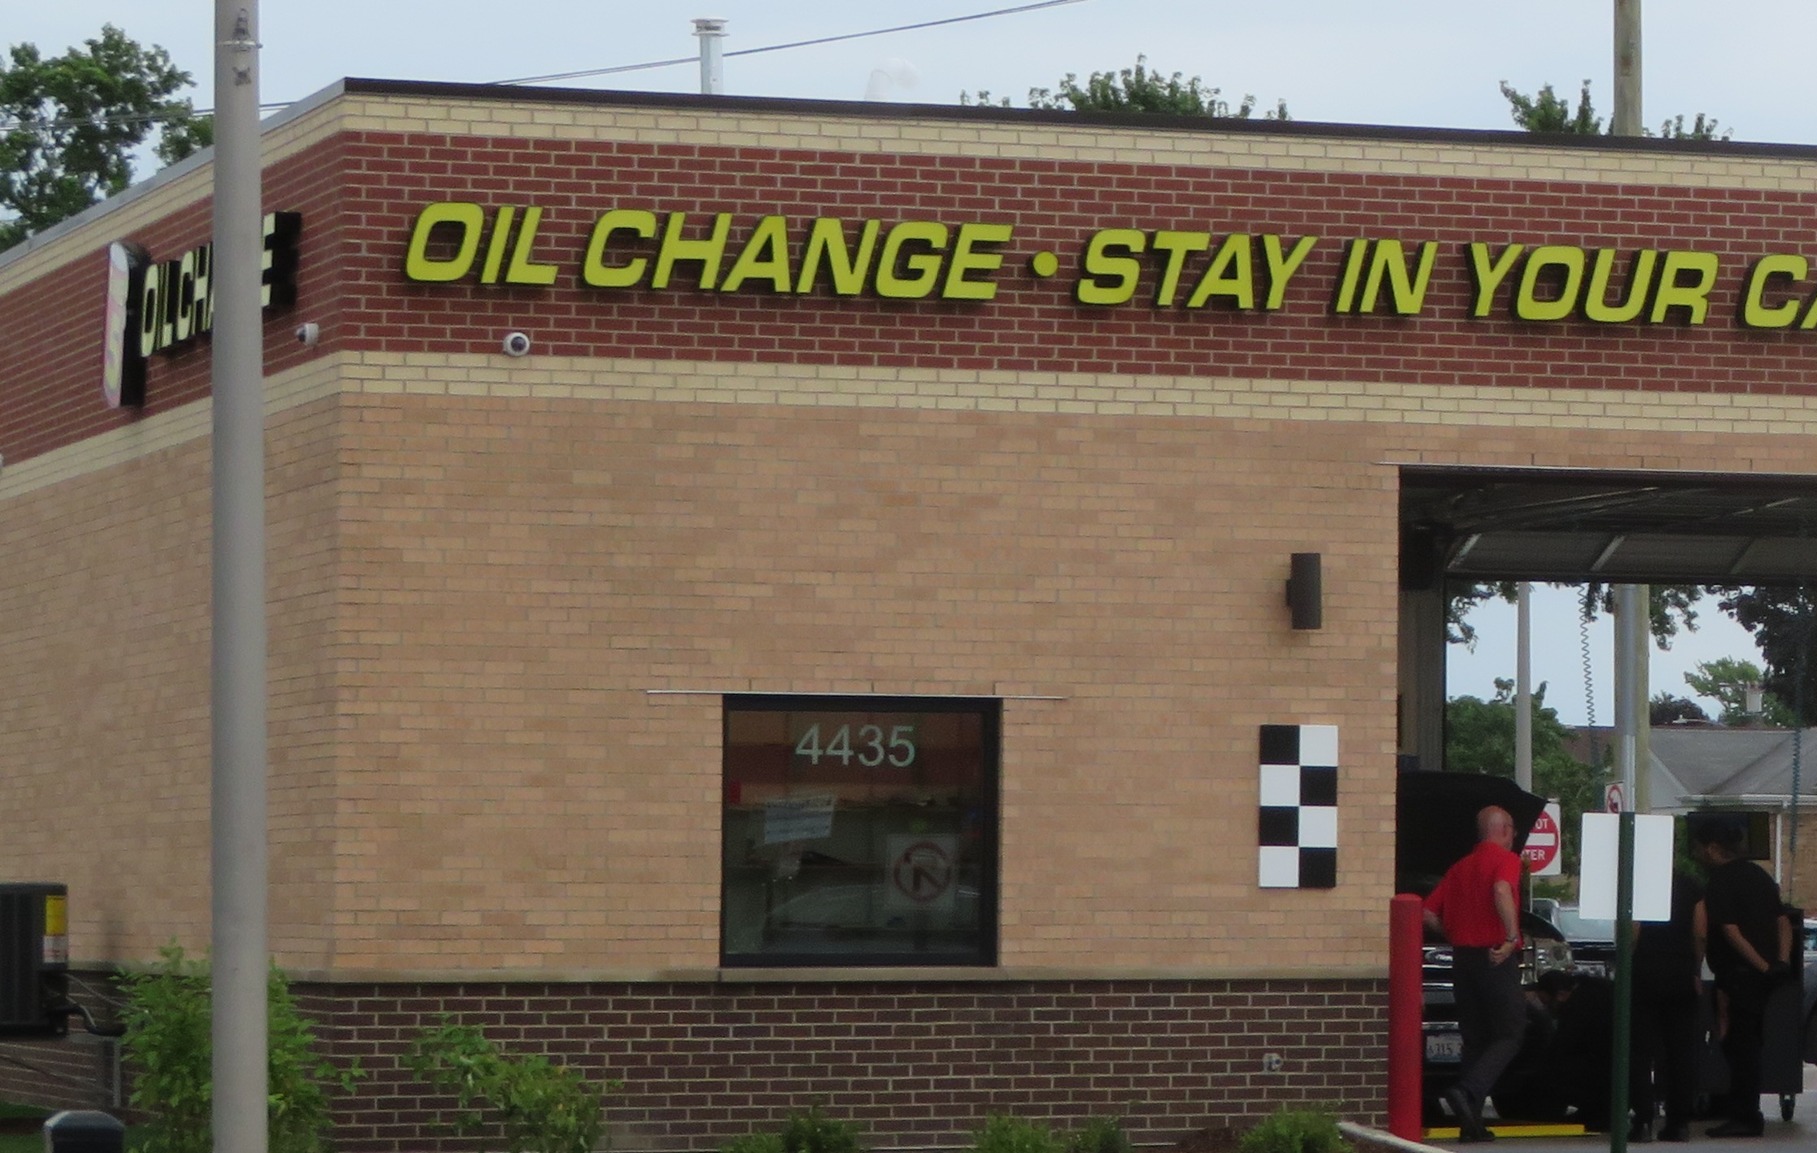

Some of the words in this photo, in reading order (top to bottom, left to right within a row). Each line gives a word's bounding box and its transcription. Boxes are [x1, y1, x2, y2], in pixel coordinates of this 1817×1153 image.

[405, 202, 560, 284] OIL
[582, 208, 1014, 300] CHANGE
[1076, 227, 1318, 311] STAY
[1335, 238, 1440, 315] IN
[1466, 242, 1720, 324] YOUR
[141, 263, 173, 358] OIL
[795, 723, 916, 768] 4435
[1534, 818, 1549, 830] OT
